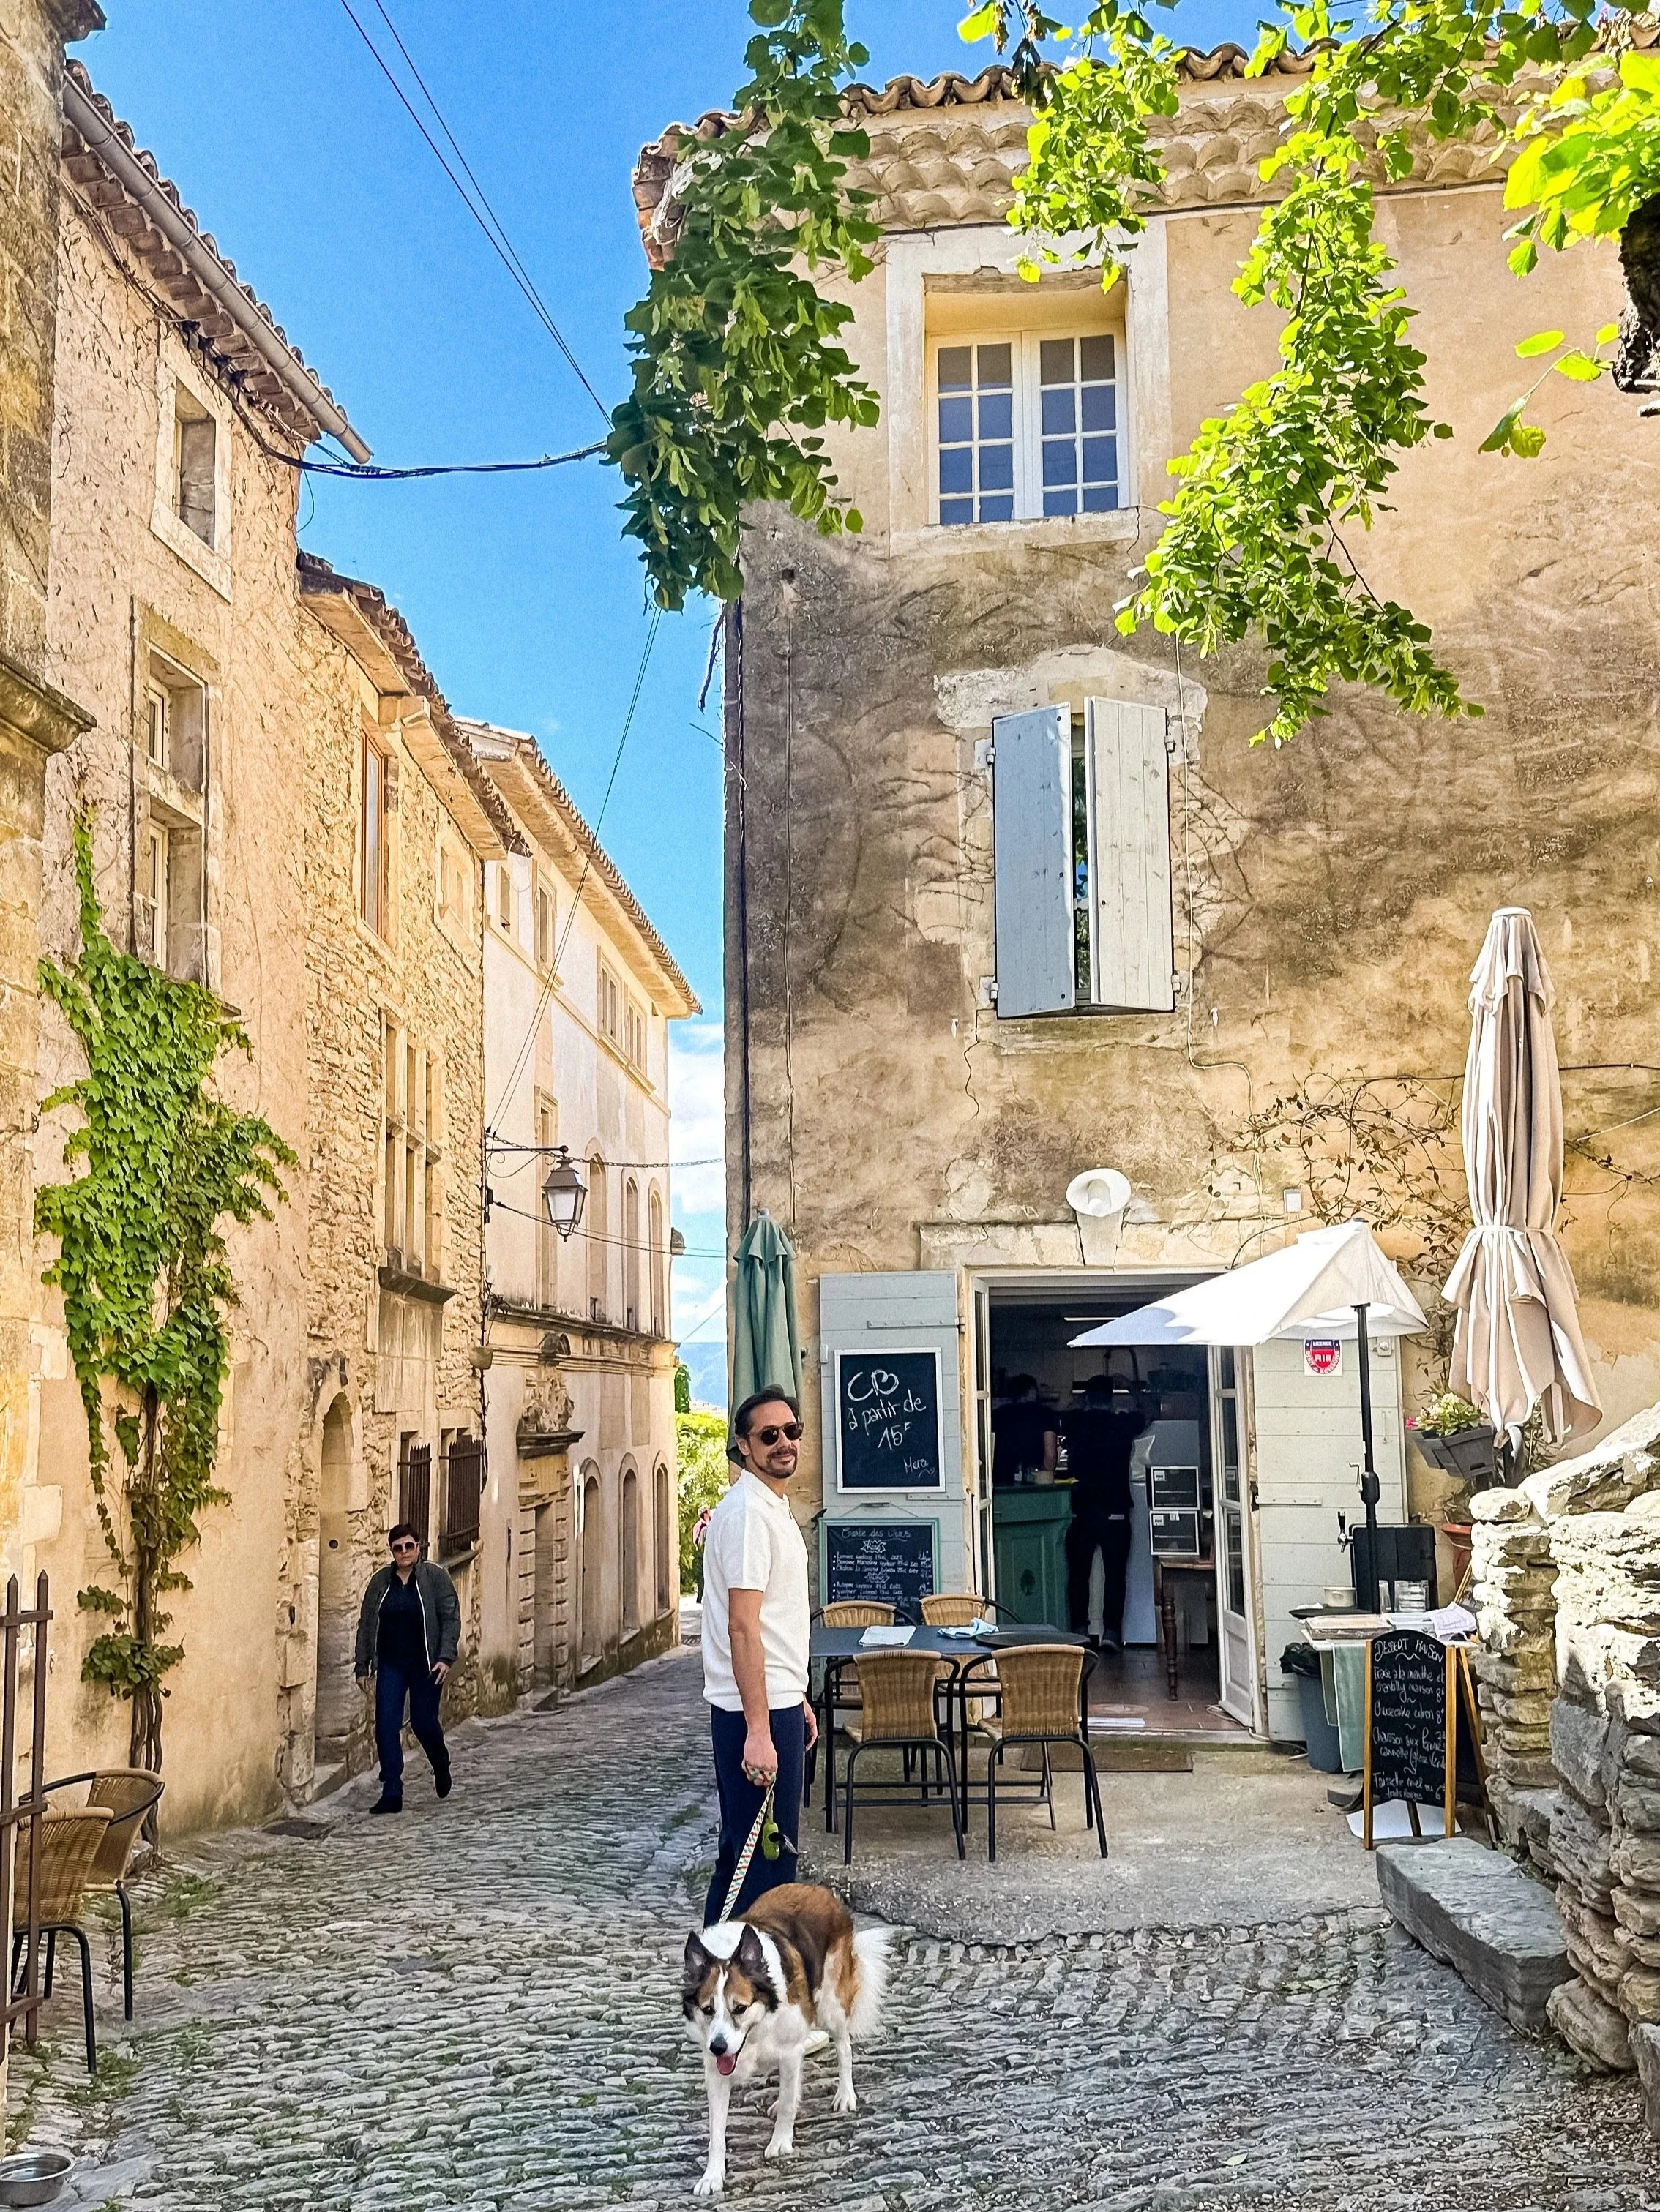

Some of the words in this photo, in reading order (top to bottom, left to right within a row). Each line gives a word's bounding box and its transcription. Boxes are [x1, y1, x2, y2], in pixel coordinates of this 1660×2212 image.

[847, 1368, 900, 1401] CB
[861, 1398, 901, 1436] partir
[903, 1389, 927, 1413] de
[868, 1528, 884, 1537] des
[1398, 1663, 1406, 1681] la
[1436, 1667, 1445, 1684] et
